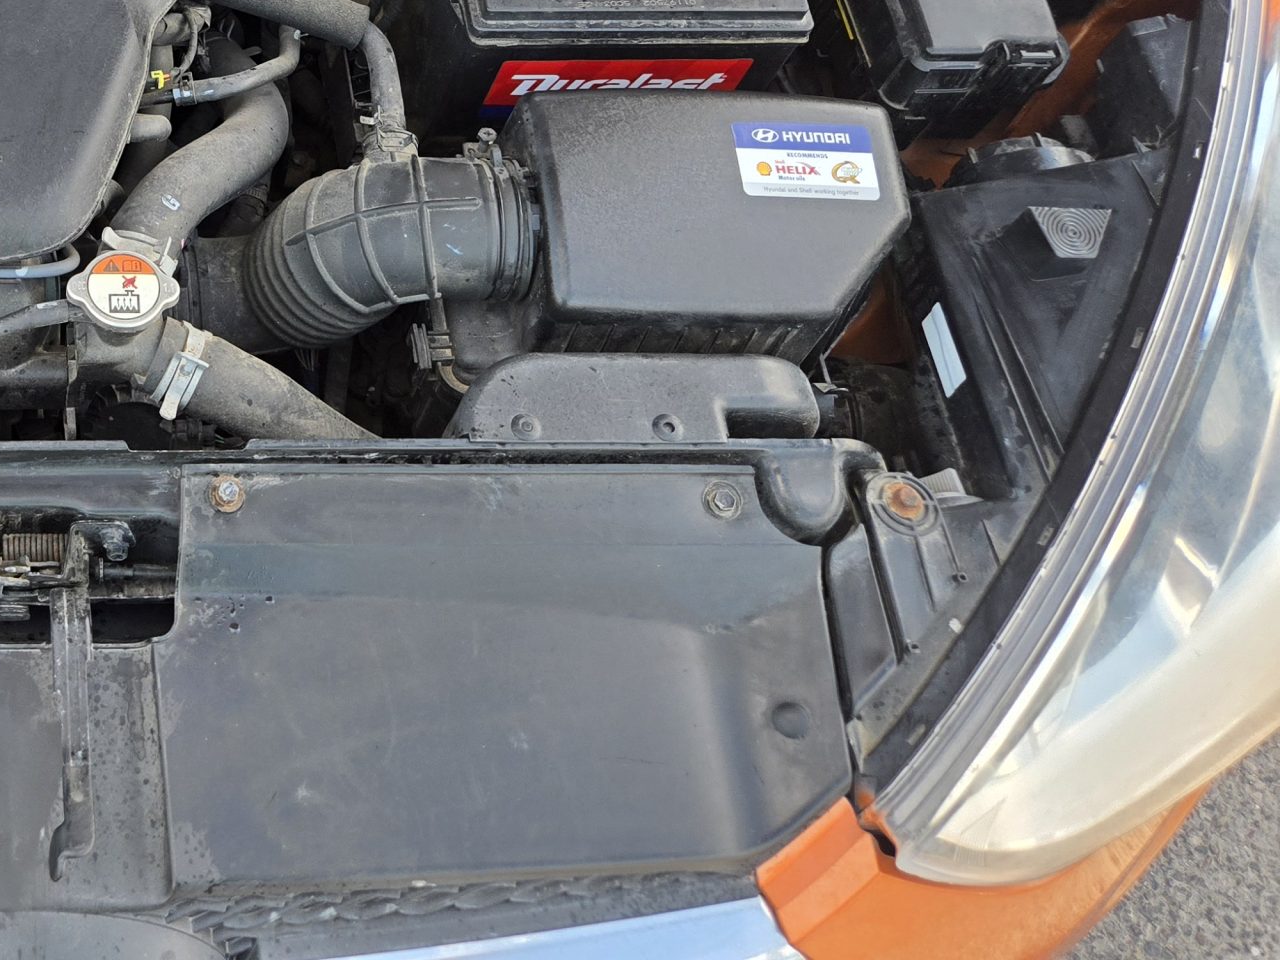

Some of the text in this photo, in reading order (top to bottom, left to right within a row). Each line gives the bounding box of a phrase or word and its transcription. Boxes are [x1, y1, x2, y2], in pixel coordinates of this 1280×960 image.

[510, 73, 727, 96] Duralast
[782, 131, 851, 144] HYUNDAI
[775, 165, 818, 176] HELIX
[763, 186, 787, 194] Hyundai
